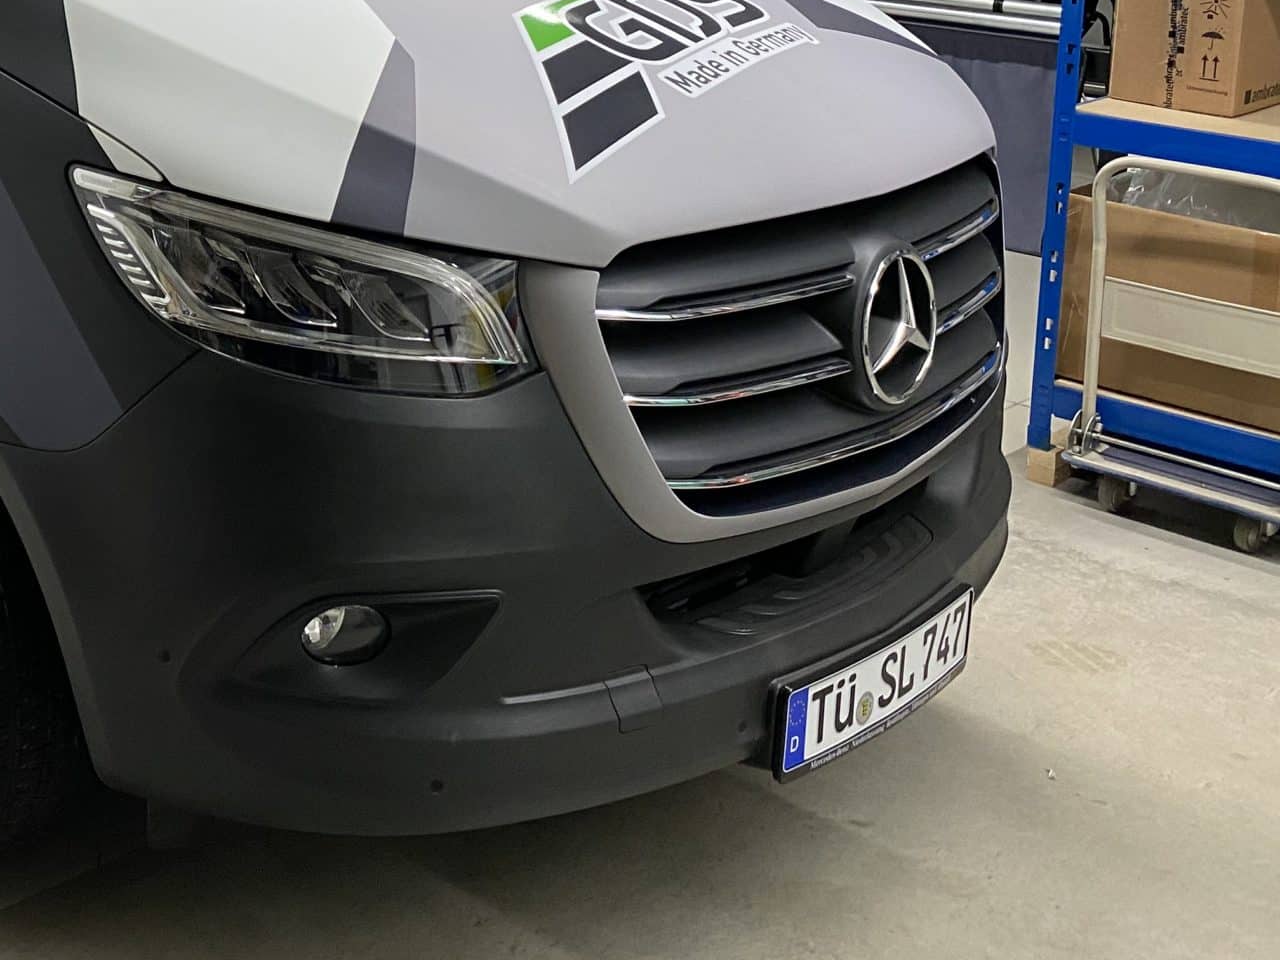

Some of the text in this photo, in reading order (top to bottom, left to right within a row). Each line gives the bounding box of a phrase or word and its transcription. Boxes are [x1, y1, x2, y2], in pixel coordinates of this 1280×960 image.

[664, 24, 815, 94] Made in Germany
[812, 672, 858, 744] TÜ
[878, 645, 915, 708] SL
[923, 600, 967, 681] 747
[790, 735, 800, 753] D
